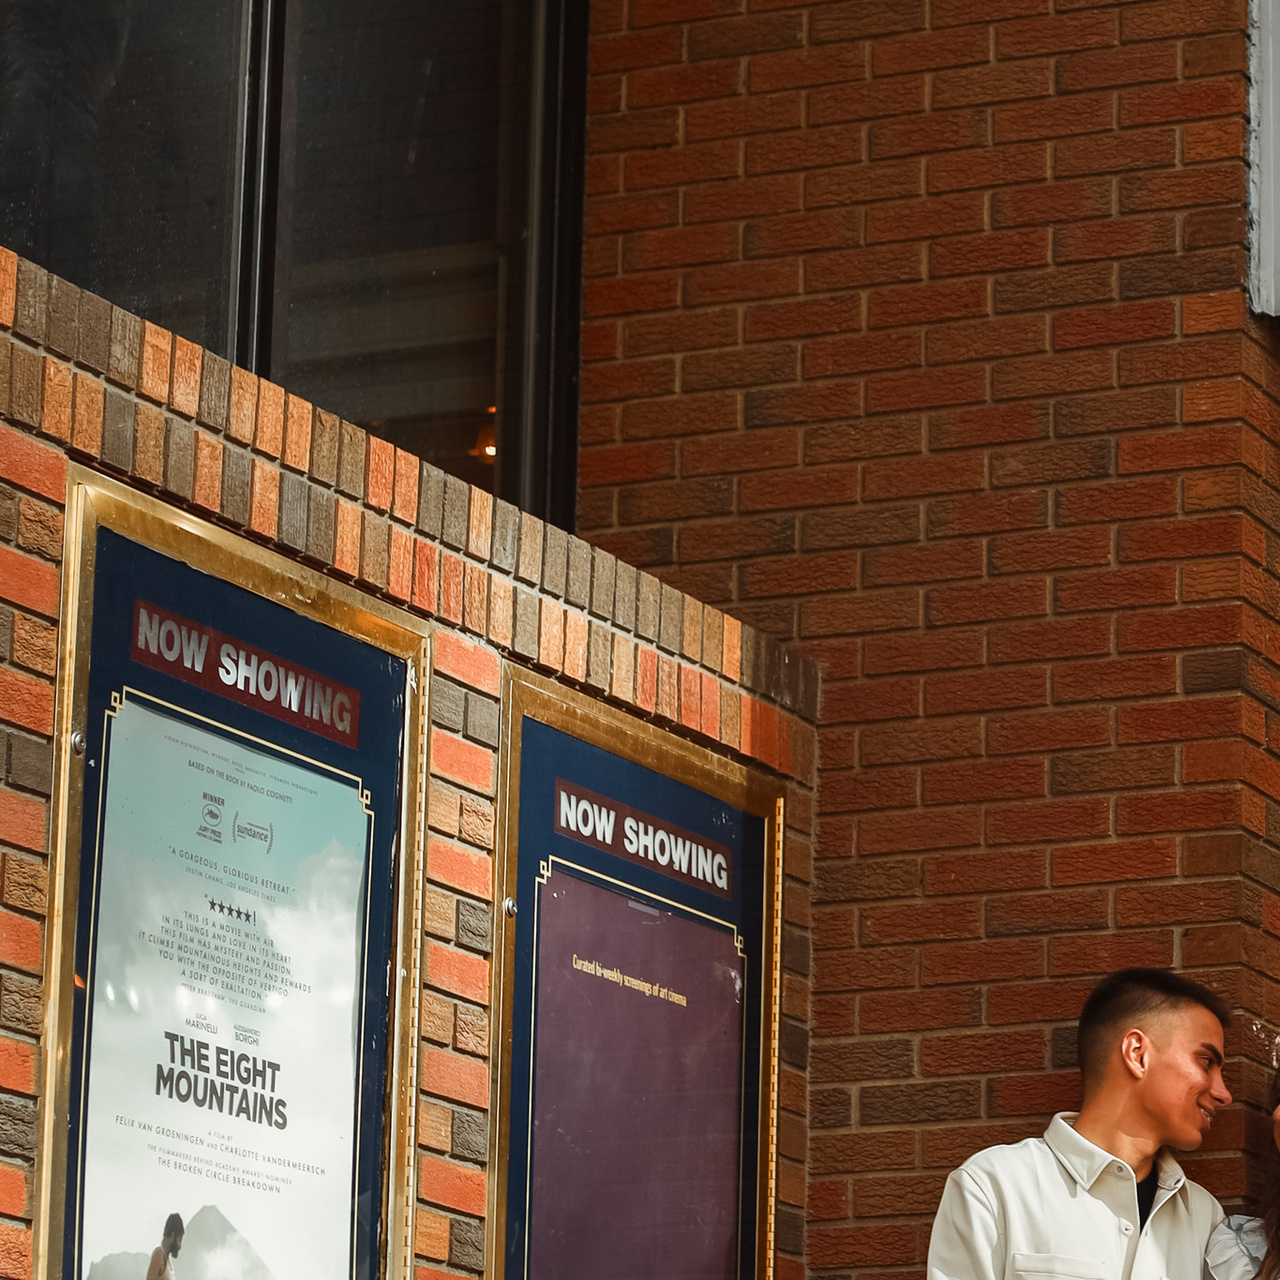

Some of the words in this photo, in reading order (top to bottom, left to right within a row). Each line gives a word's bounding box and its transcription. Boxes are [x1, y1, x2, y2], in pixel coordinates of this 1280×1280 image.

[138, 607, 210, 674] NOW
[218, 642, 352, 735] SHOWING
[188, 759, 205, 772] BASED
[206, 766, 215, 775] ON
[216, 769, 225, 780] THE
[226, 773, 240, 786] BOOK
[240, 779, 246, 788] BY
[247, 782, 265, 795] PAOLO
[266, 789, 294, 804] COGNETTI
[202, 791, 225, 807] WINNER
[237, 824, 269, 842] sundance
[559, 789, 615, 846] NOW
[623, 815, 729, 892] SHOWING
[179, 849, 220, 872] GORGEOUS,
[223, 865, 258, 885] GLORIOUS
[161, 925, 176, 938] THIS
[179, 932, 194, 943] FILM
[198, 938, 211, 949] HAS
[214, 944, 243, 959] MYSTERY
[246, 954, 260, 966] AND
[162, 915, 170, 924] IN
[173, 918, 183, 929] ITS
[186, 922, 209, 937] LUNGS
[212, 932, 226, 943] AND
[229, 937, 246, 950] LOVE
[249, 944, 257, 953] IN
[260, 947, 269, 957] ITS
[184, 911, 199, 923] THIS
[202, 917, 208, 926] IS
[220, 923, 241, 937] MOVIE
[244, 931, 260, 943] WITH
[138, 931, 146, 940] IT
[148, 933, 174, 949] CLIMBS
[177, 943, 230, 967] MOUNTAINOUS
[232, 961, 262, 977] HEIGHTS
[264, 972, 279, 983] AND
[280, 976, 312, 994] REWARDS
[159, 949, 174, 961] YOU
[177, 955, 195, 967] WITH
[198, 961, 209, 973] THE
[212, 966, 246, 984] OPPOSITE
[247, 977, 257, 987] OF
[189, 970, 207, 983] SORT
[209, 977, 218, 986] OF
[572, 953, 596, 976] Curated
[596, 960, 624, 987] bi-weekly
[624, 974, 652, 997] screenings
[652, 982, 660, 996] of
[660, 987, 668, 1001] art
[668, 987, 687, 1007] cinema
[185, 1018, 218, 1035] MARINELLI
[235, 1031, 260, 1047] BORGHI
[164, 1030, 210, 1074] THE
[215, 1045, 281, 1094] EIGHT
[155, 1063, 288, 1131] MOUNTAINS
[115, 1114, 135, 1128] FELIX
[138, 1121, 153, 1132] VAN
[155, 1125, 205, 1146] GROENINGEN
[206, 1142, 218, 1150] AND
[219, 1143, 259, 1161] CHARLOTTE
[261, 1154, 326, 1176] VANDERMEERSCH
[158, 1156, 171, 1168] THE
[173, 1161, 203, 1176] BROKEN
[205, 1169, 230, 1183] CIRCLE
[233, 1175, 281, 1194] BREAKDOWN
